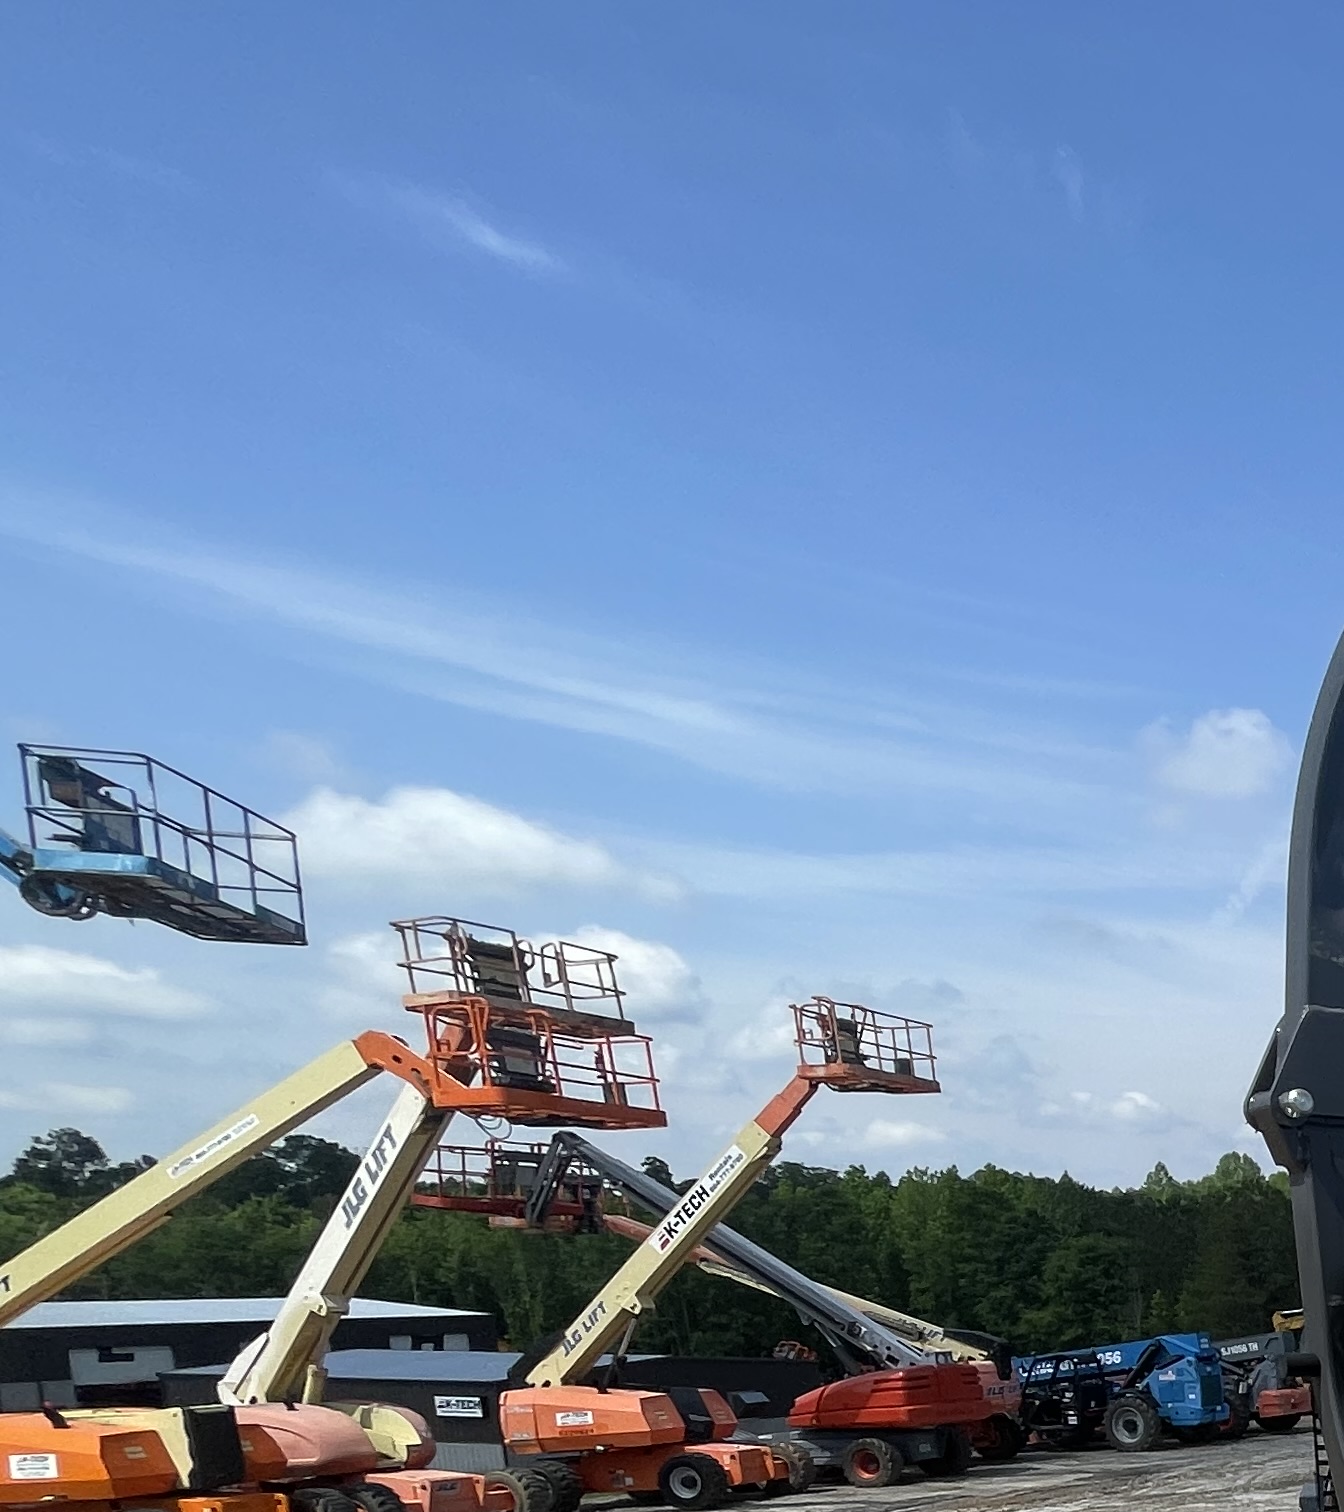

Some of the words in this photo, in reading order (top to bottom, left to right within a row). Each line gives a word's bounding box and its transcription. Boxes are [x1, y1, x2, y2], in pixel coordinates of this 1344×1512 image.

[342, 1177, 368, 1229] JLG
[365, 1123, 397, 1185] LIFT
[663, 1184, 710, 1240] K-TECH
[562, 1329, 582, 1357] JLG
[582, 1301, 607, 1333] LIFT
